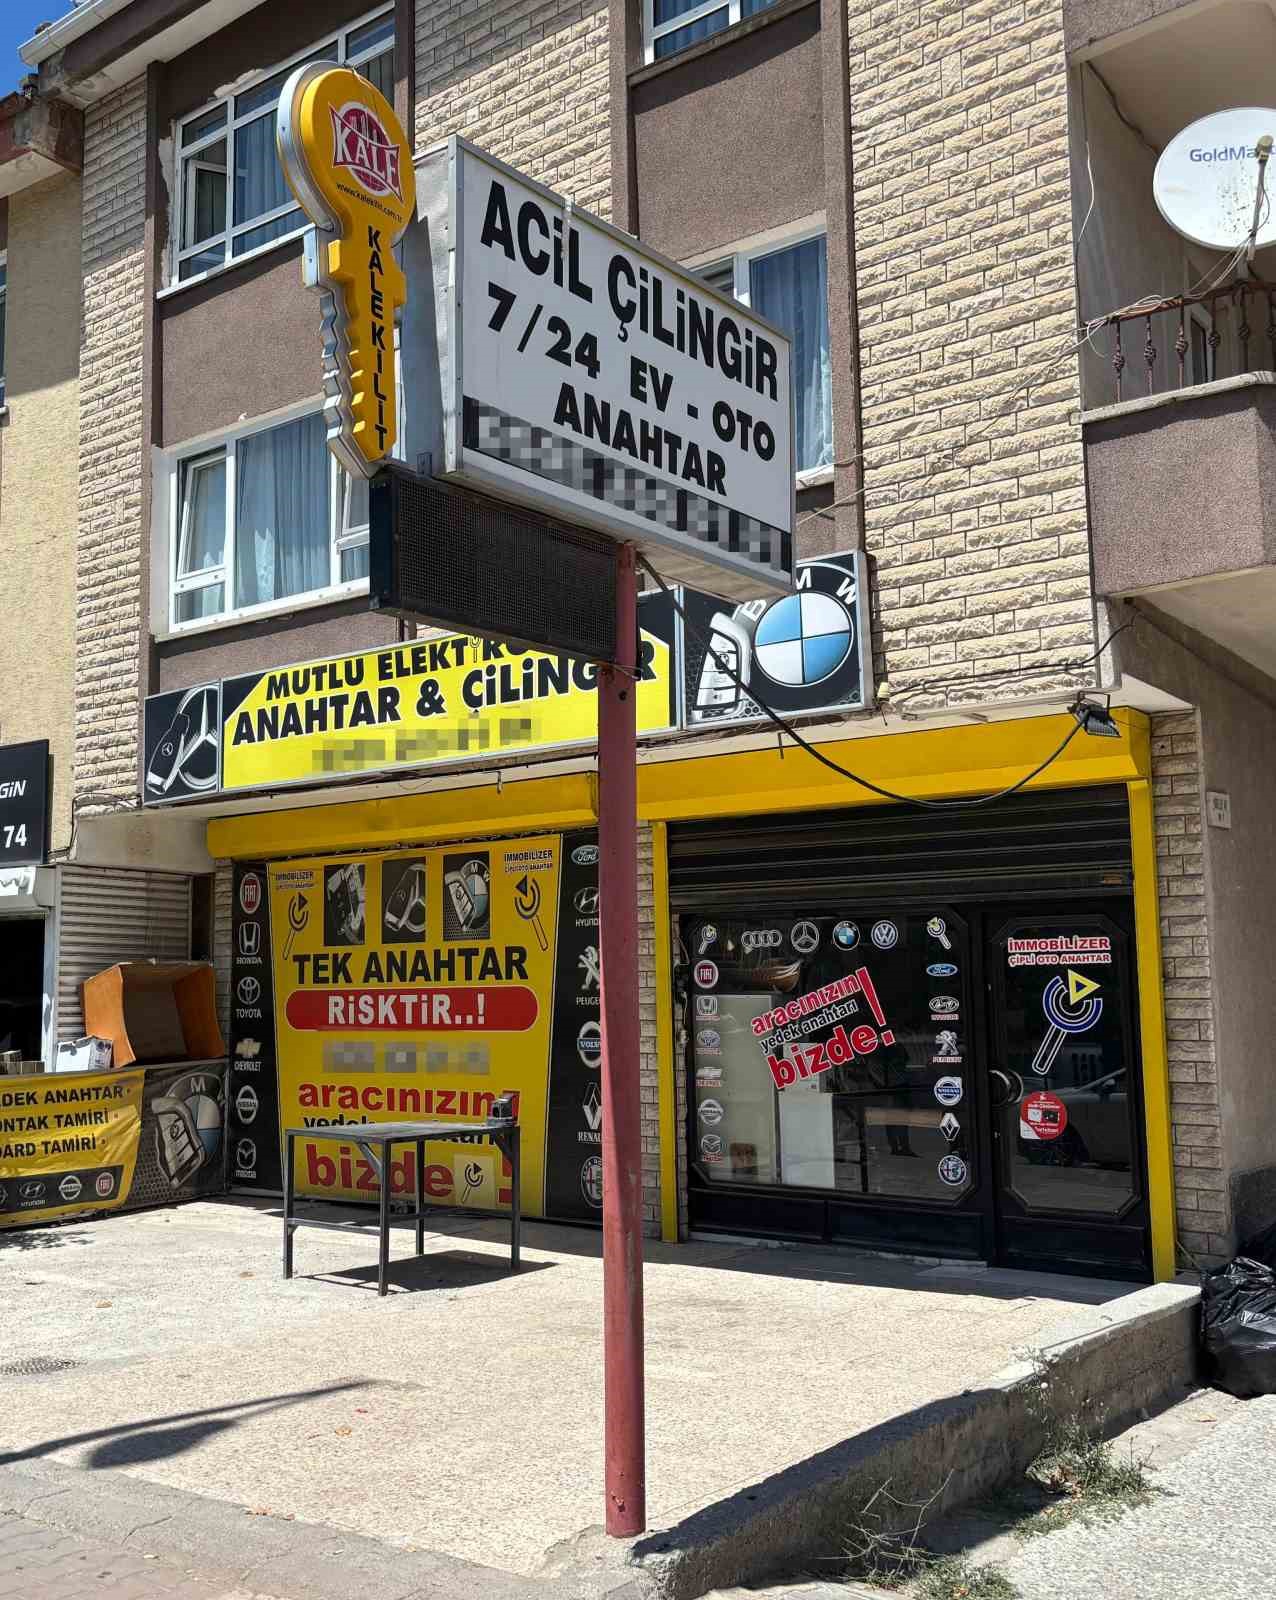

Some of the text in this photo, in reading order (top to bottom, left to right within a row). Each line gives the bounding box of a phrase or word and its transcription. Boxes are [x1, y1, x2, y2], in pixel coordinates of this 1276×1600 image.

[335, 112, 400, 192] KALE
[631, 355, 673, 413] EV
[713, 400, 775, 461] OTO
[553, 382, 727, 497] ANAHTAR
[266, 658, 364, 701] MUTLU
[232, 686, 401, 746] ANAHTAR
[416, 678, 447, 717] &
[4, 823, 27, 849] 74
[576, 918, 599, 928] HYUND
[236, 957, 262, 965] HONDA
[293, 946, 529, 984] TEK ANAHTAR
[1037, 954, 1059, 964] OTO
[1060, 953, 1111, 964] ANAHTAR
[576, 996, 600, 1006] PEUGE
[236, 1009, 263, 1019] TOYOTA
[760, 1024, 802, 1055] yedek
[0, 1085, 123, 1107] DEK ANAHTAR
[0, 1115, 49, 1132] NTAK
[0, 1142, 36, 1159] ARD
